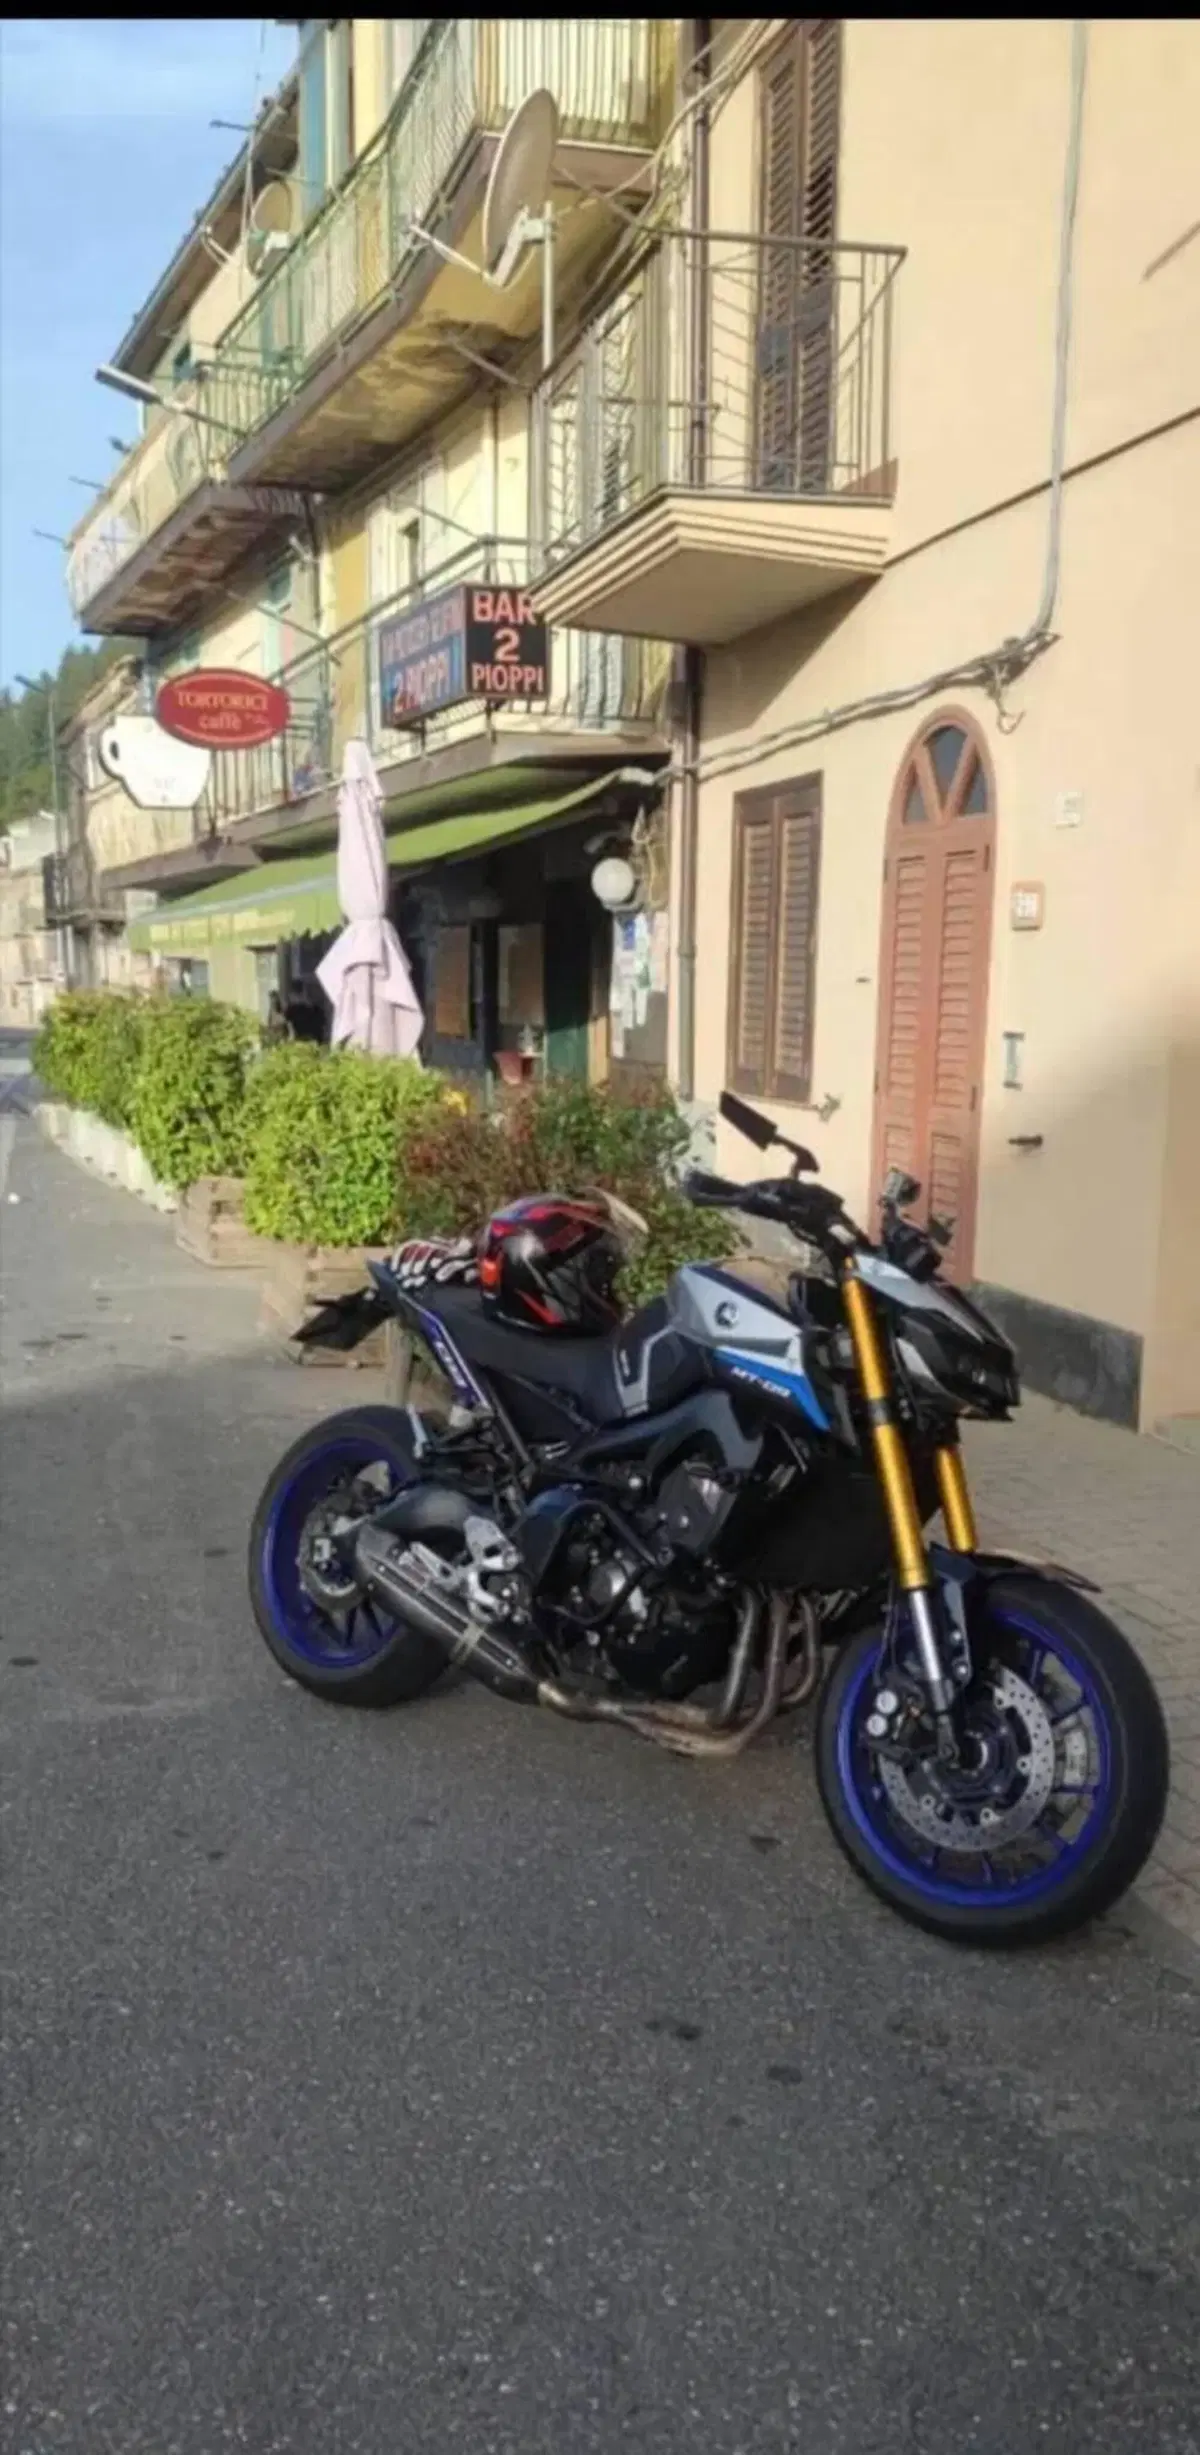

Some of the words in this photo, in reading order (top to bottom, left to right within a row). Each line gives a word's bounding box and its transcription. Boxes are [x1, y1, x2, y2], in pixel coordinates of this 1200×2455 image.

[473, 590, 536, 625] BAR
[494, 627, 520, 662] 2
[393, 670, 404, 714] 2
[405, 651, 450, 709] PIOPPI
[472, 662, 544, 692] PIOPPI
[177, 690, 268, 711] TORTORICI
